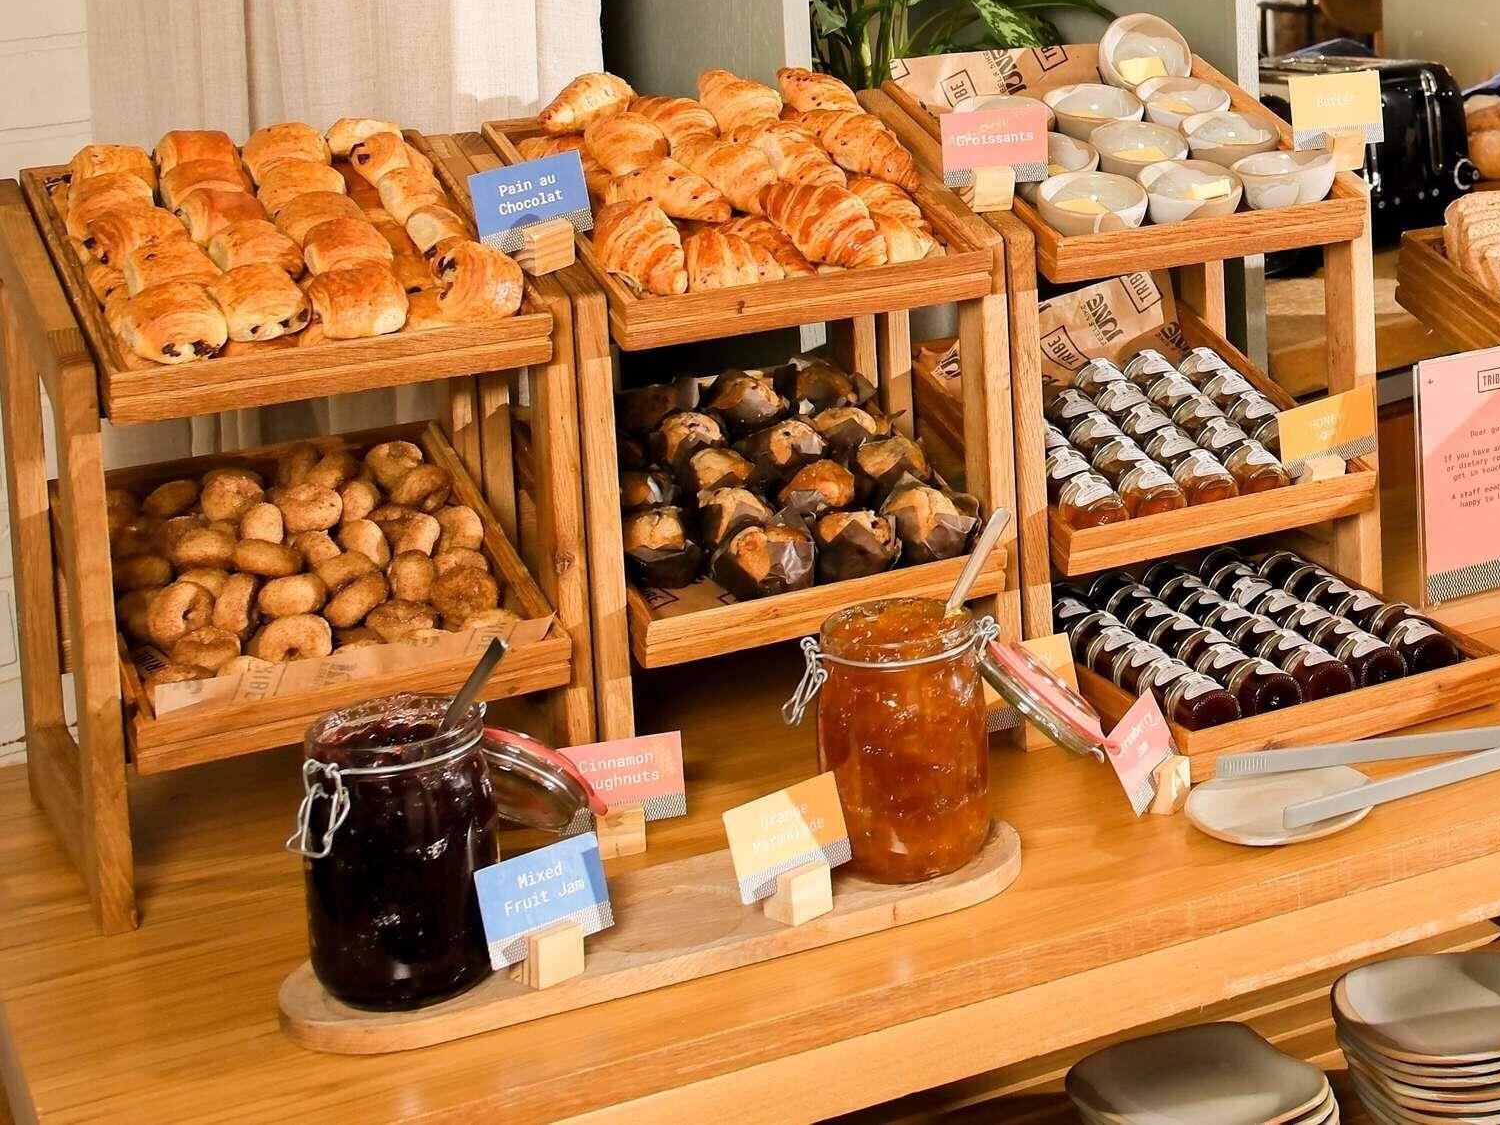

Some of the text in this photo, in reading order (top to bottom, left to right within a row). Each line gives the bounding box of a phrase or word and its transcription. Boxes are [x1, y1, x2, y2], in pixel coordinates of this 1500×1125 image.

[956, 131, 1034, 147] Croissants
[498, 174, 556, 197] Pain au
[499, 189, 563, 215] Chocolat
[1086, 293, 1124, 342] JUNE
[1048, 335, 1079, 366] TRIBE
[1470, 429, 1486, 438] Dear
[1444, 454, 1452, 463] If
[1456, 452, 1470, 461] you
[1473, 447, 1490, 456] have
[1446, 465, 1455, 473] or
[1459, 458, 1488, 469] dietary
[1453, 472, 1465, 483] get
[1470, 469, 1478, 477] in
[1460, 487, 1480, 499] staff
[1460, 498, 1481, 508] happy
[578, 752, 654, 774] Cinnamon
[590, 770, 660, 791] oughnuts
[761, 803, 808, 829] Orange
[752, 818, 825, 853] Marmalade
[517, 861, 562, 889] Mixed
[504, 879, 586, 916] Fruit Jam
